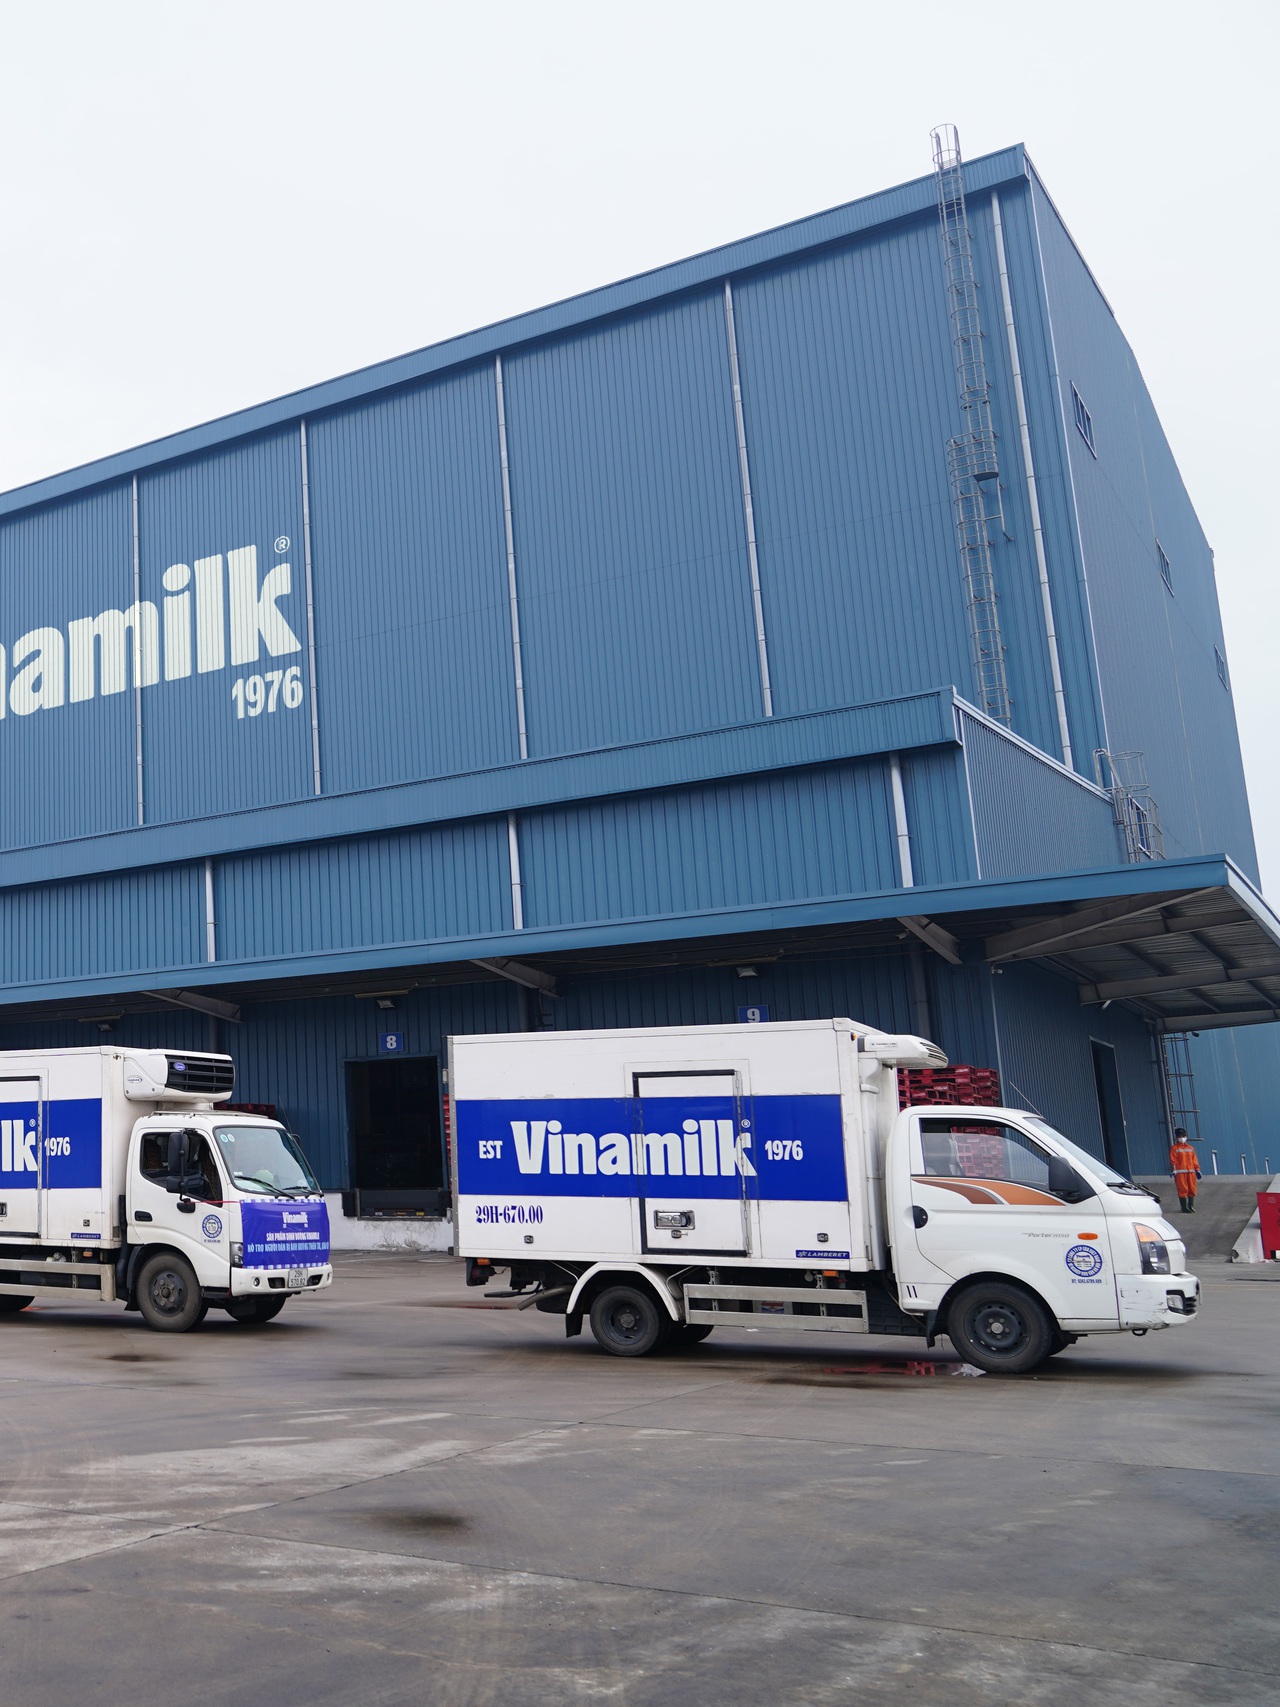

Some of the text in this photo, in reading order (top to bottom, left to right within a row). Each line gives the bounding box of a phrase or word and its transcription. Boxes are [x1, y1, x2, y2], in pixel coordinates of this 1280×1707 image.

[232, 666, 304, 719] 1976
[747, 1008, 760, 1023] 9
[386, 1035, 397, 1049] 8
[44, 1137, 71, 1157] 1976
[478, 1119, 804, 1176] EST Vinamilk 1976
[475, 1205, 543, 1224] 29H-670.00
